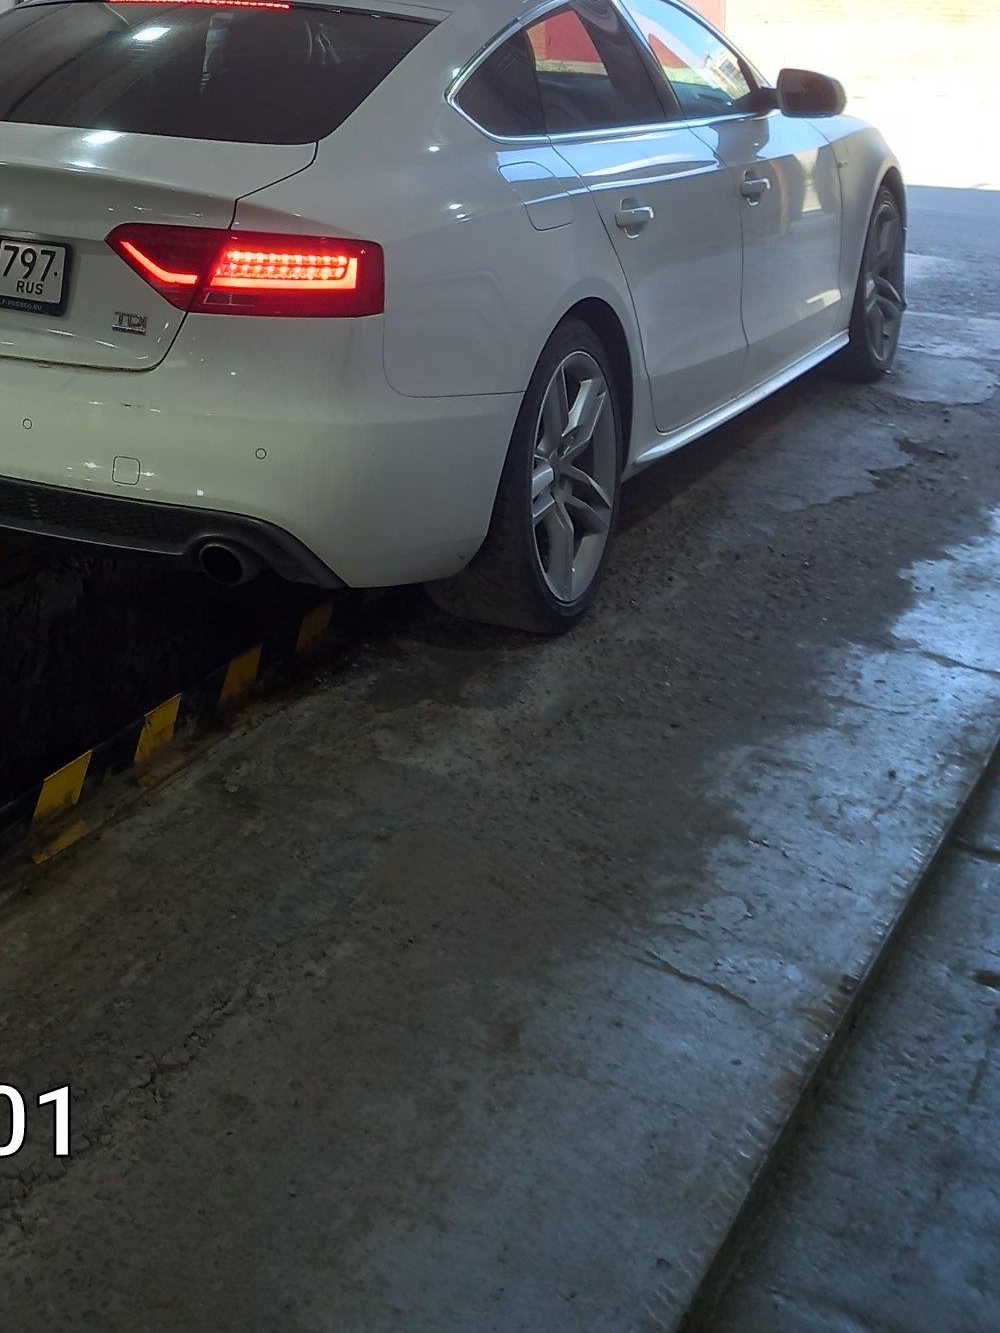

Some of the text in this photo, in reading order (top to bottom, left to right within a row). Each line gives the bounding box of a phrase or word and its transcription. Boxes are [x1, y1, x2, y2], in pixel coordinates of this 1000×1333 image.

[2, 245, 56, 282] 797
[16, 281, 43, 295] RUS
[114, 311, 147, 328] TDI
